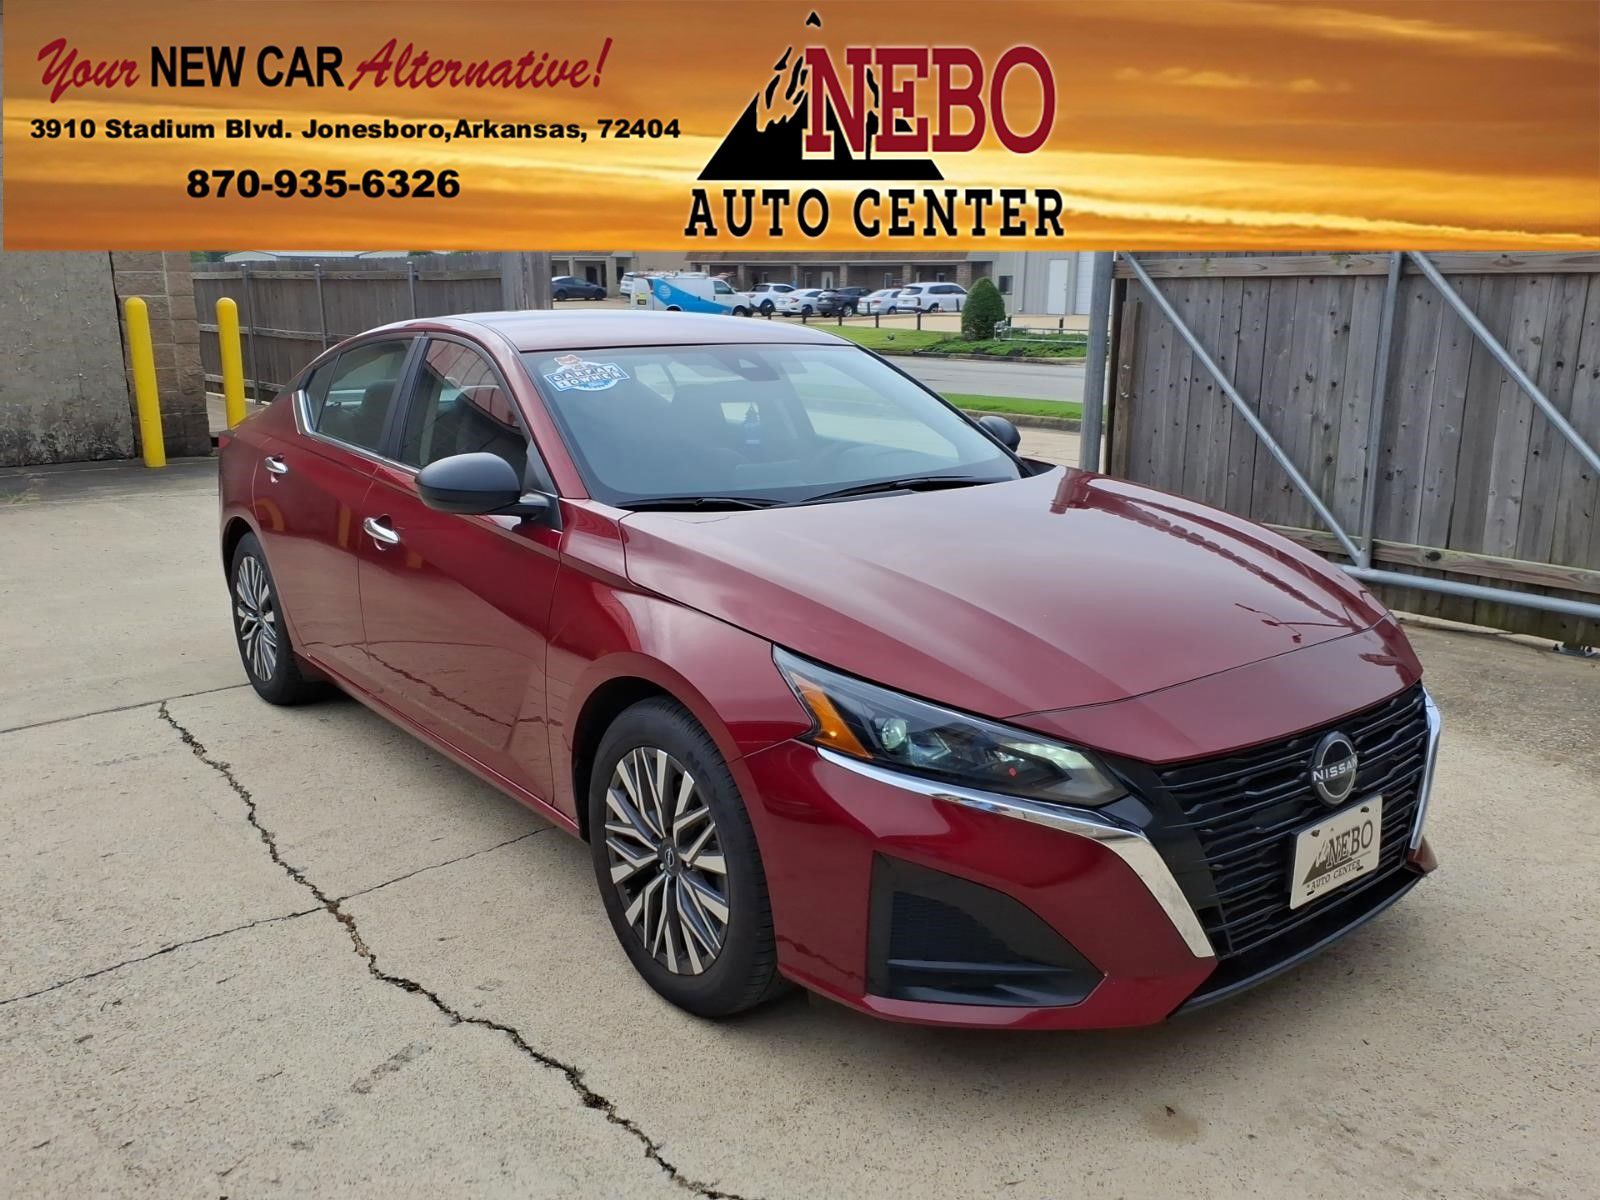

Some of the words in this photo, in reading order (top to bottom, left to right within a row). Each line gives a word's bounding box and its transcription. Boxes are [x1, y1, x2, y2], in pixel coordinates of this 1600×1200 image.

[1312, 755, 1358, 782] NISSAN
[1326, 820, 1373, 867] NEBO
[1310, 873, 1331, 890] AUTO
[1334, 859, 1361, 879] CENTER
